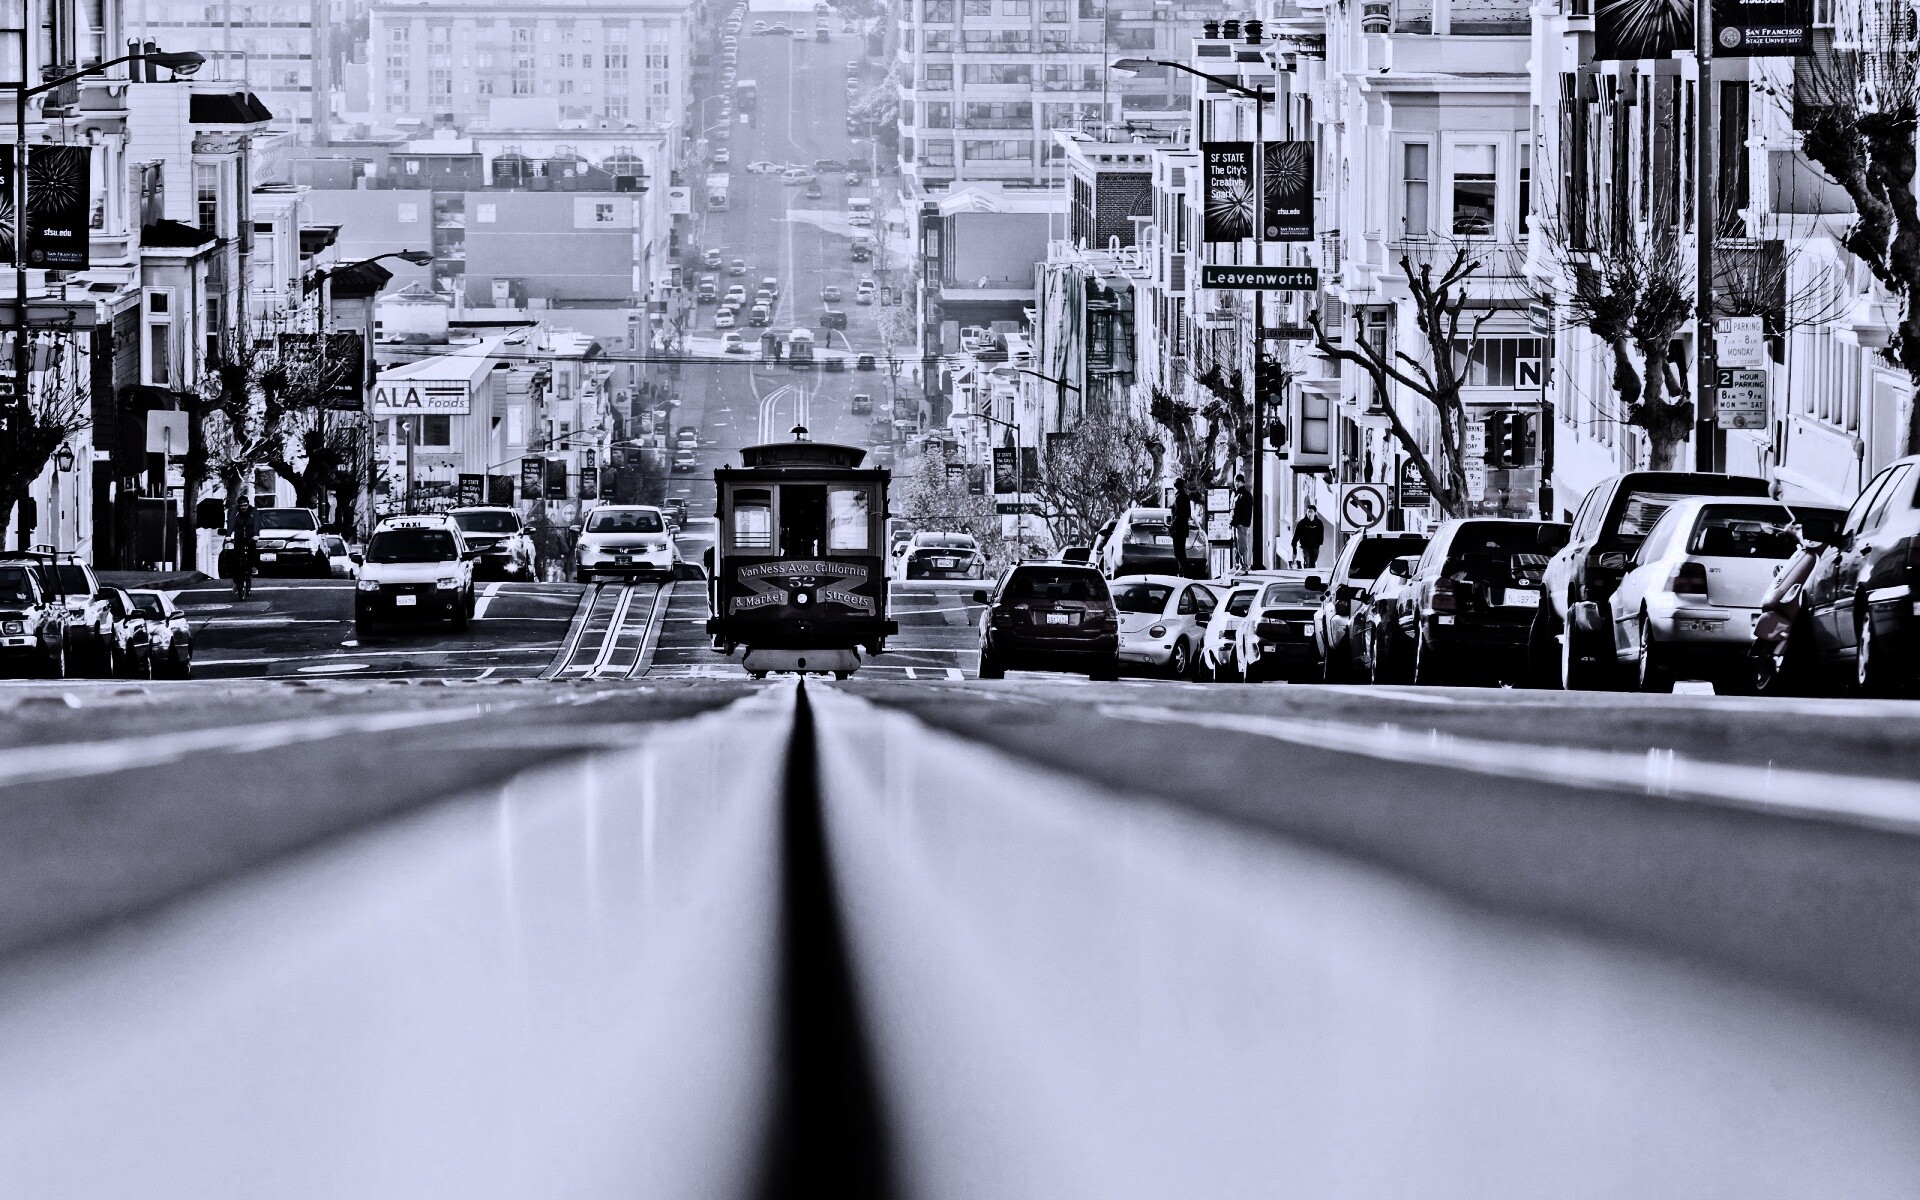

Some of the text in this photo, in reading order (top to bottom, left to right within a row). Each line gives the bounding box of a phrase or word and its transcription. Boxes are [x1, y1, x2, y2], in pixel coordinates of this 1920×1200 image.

[1210, 153, 1244, 162] SF STATE
[1210, 165, 1247, 176] The City's
[1211, 178, 1244, 186] Creative
[1211, 190, 1233, 200] Spark
[44, 228, 72, 237] sfsu.edu
[1207, 271, 1312, 285] Leavenworth
[1719, 320, 1760, 332] NO PARKING
[1745, 335, 1749, 344] 8
[1728, 348, 1754, 356] MONDAY
[1721, 373, 1730, 384] 2
[1722, 390, 1727, 399] 8
[1748, 390, 1753, 399] 9
[428, 397, 465, 407] Foods
[741, 567, 759, 577] Van
[760, 564, 785, 574] Ness
[815, 563, 866, 576] California
[736, 590, 868, 607] & Market Streets
